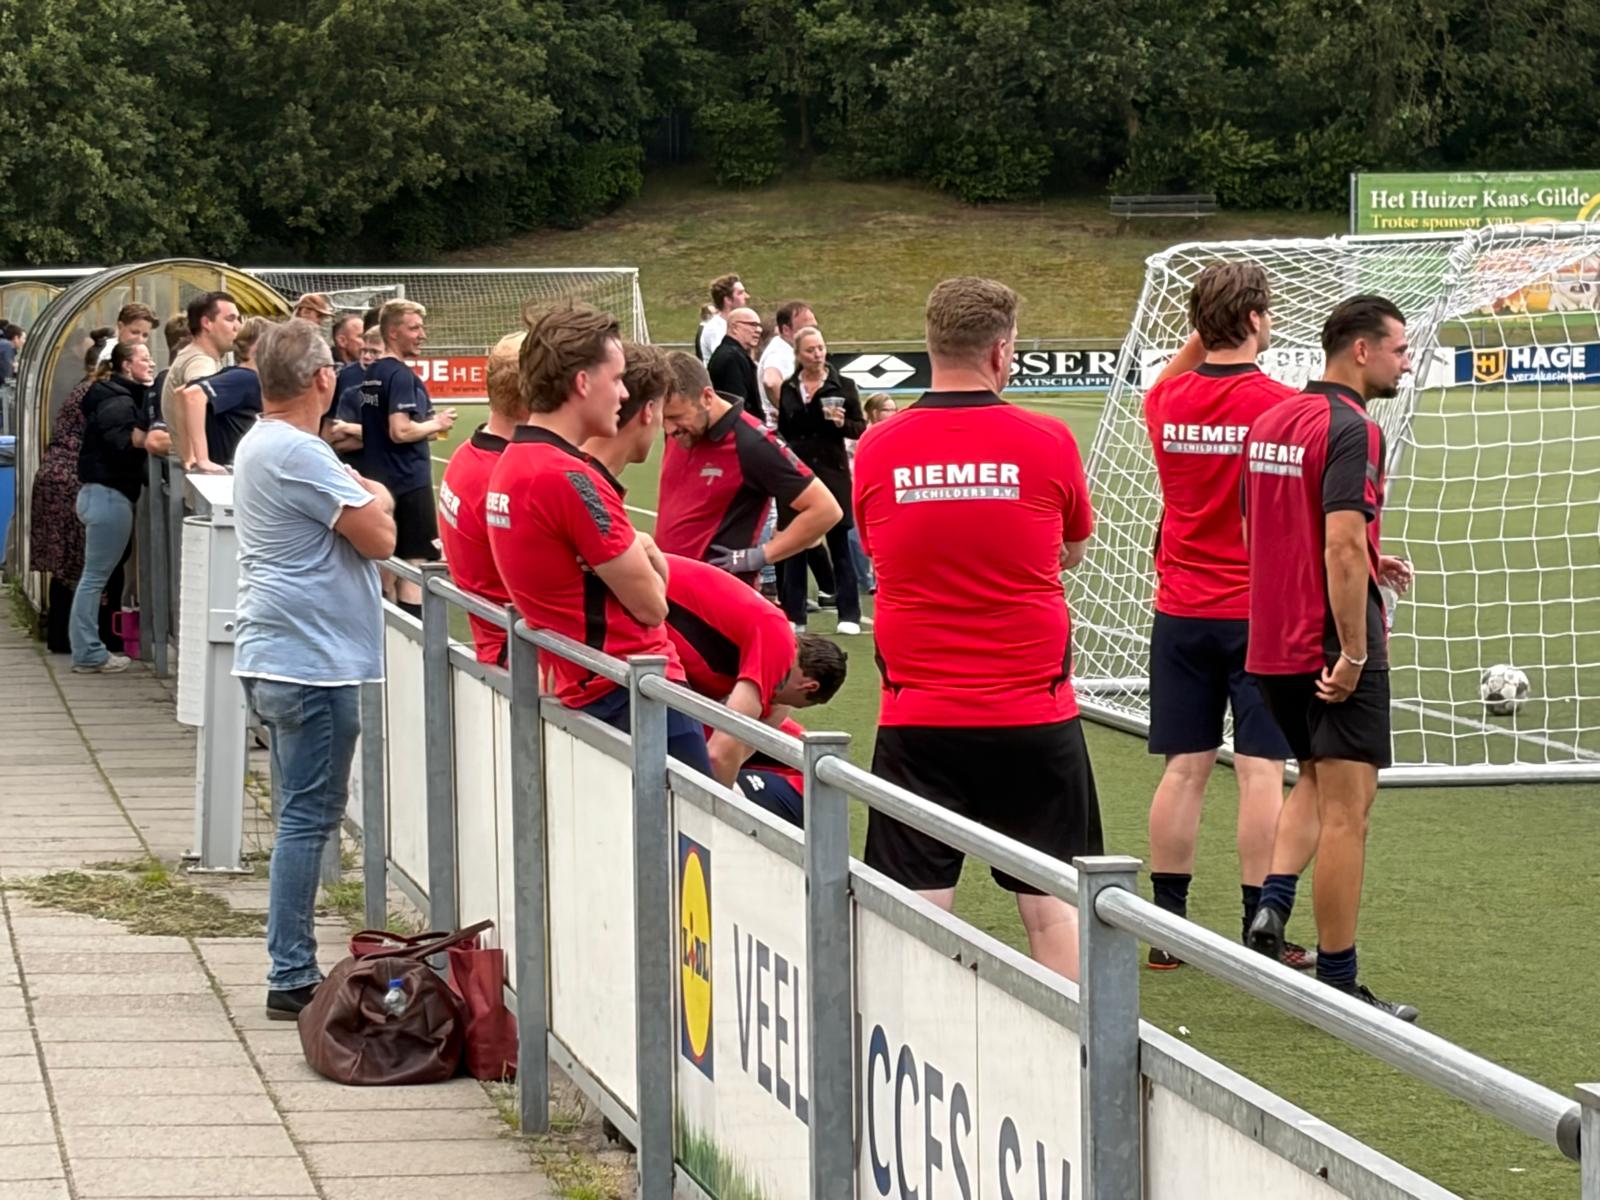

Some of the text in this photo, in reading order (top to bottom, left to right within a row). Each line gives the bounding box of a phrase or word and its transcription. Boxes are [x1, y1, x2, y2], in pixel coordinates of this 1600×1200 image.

[1370, 187, 1590, 209] Het Huizer Kaas-Gilde
[1370, 214, 1419, 229] Trotse
[1422, 213, 1481, 231] sponsor
[1511, 347, 1586, 369] HAGE
[893, 462, 1020, 489] RIEMER
[914, 487, 987, 500] SCHILDERS
